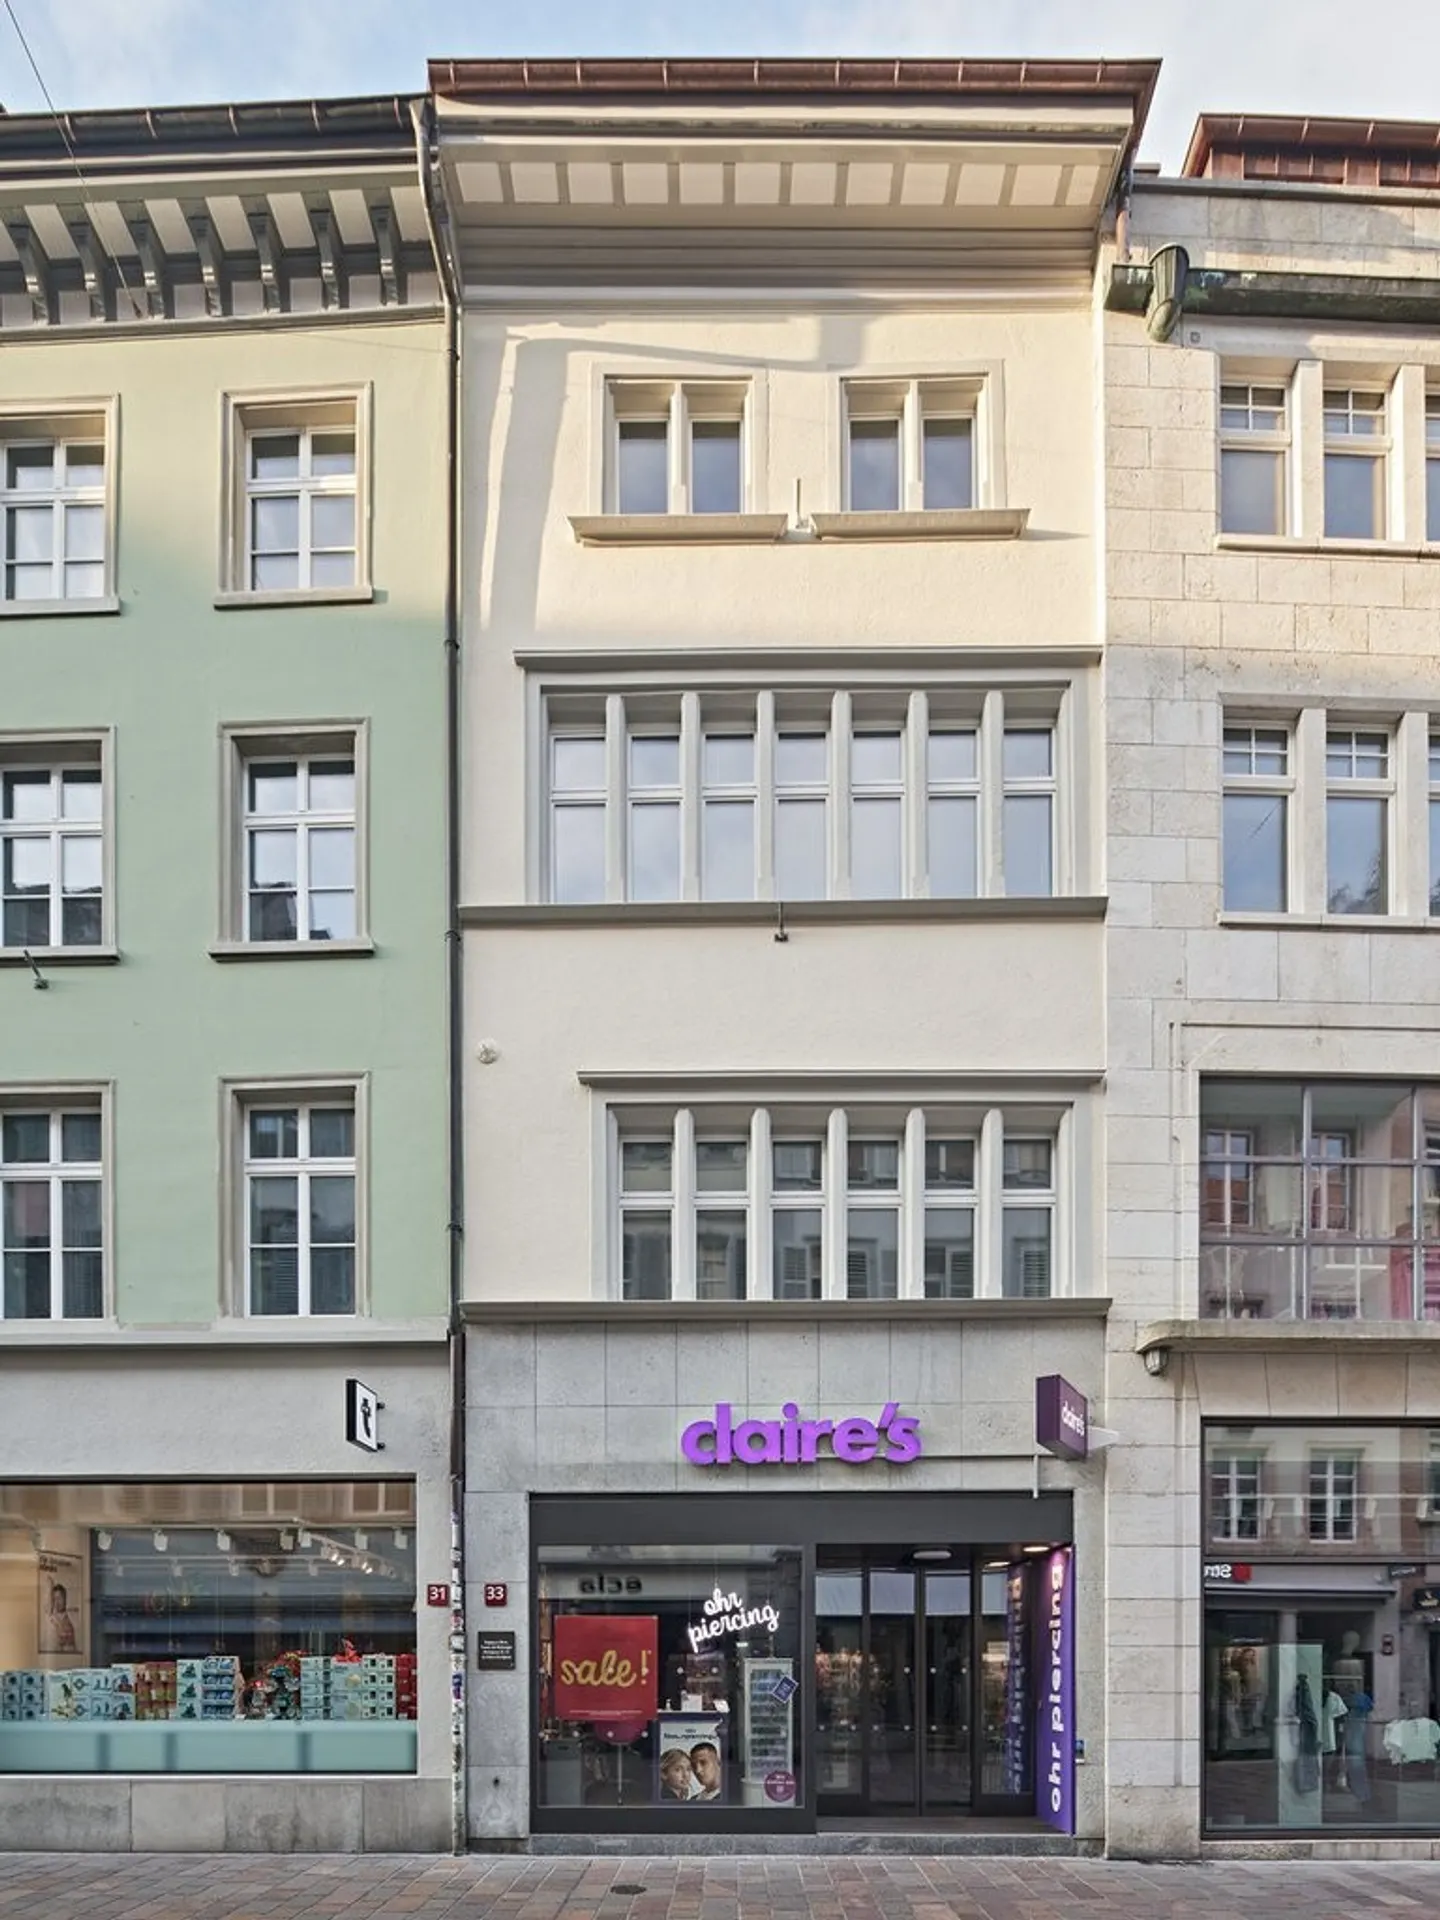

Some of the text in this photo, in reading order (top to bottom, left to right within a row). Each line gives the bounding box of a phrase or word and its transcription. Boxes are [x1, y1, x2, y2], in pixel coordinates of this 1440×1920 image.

[681, 1402, 922, 1465] claire's
[429, 1586, 446, 1601] 31
[487, 1586, 504, 1600] 33
[703, 1588, 742, 1615] ohr
[687, 1604, 780, 1653] piercing
[1049, 1563, 1064, 1813] ohr piercing
